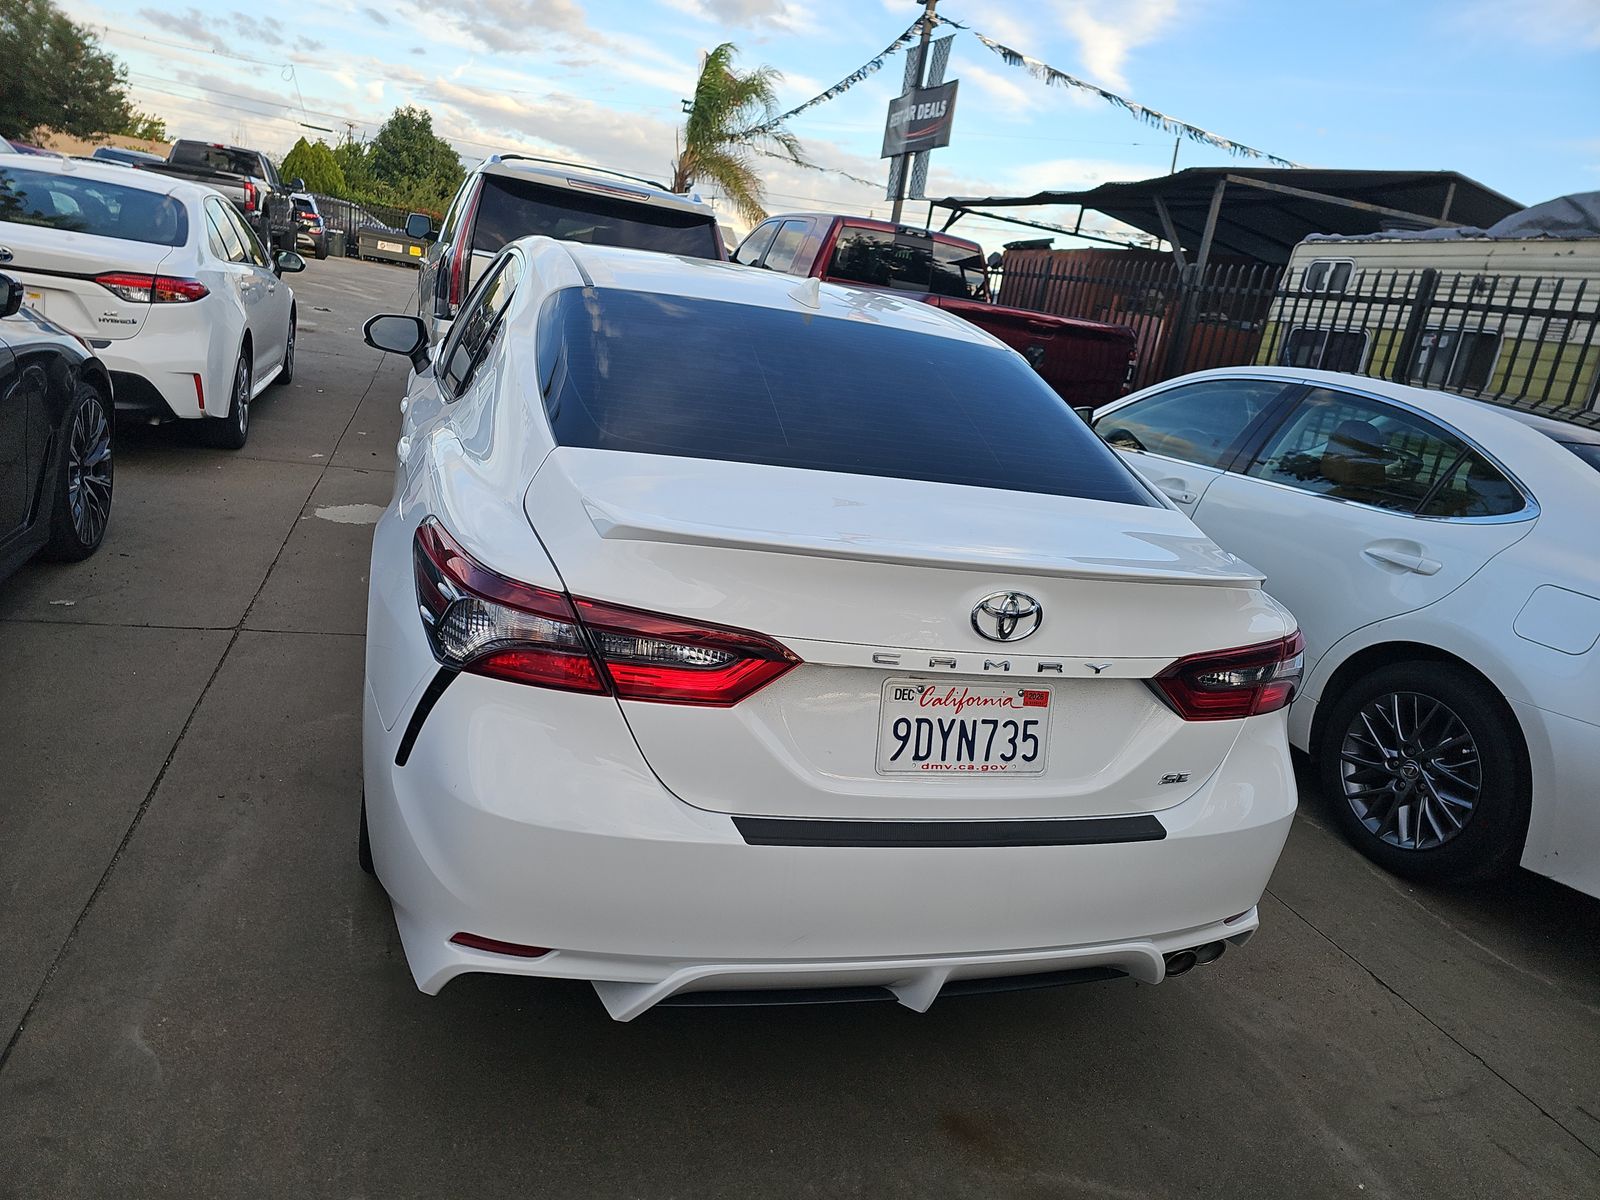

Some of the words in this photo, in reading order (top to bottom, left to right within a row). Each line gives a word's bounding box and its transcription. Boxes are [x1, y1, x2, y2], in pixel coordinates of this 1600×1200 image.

[916, 100, 947, 120] DEALS
[872, 651, 1113, 674] CAMRY
[894, 688, 915, 701] DEC
[919, 685, 1024, 715] California
[889, 717, 1040, 762] 9DYN735
[920, 762, 1008, 772] dmv.ca.gov
[1158, 772, 1191, 785] SE
